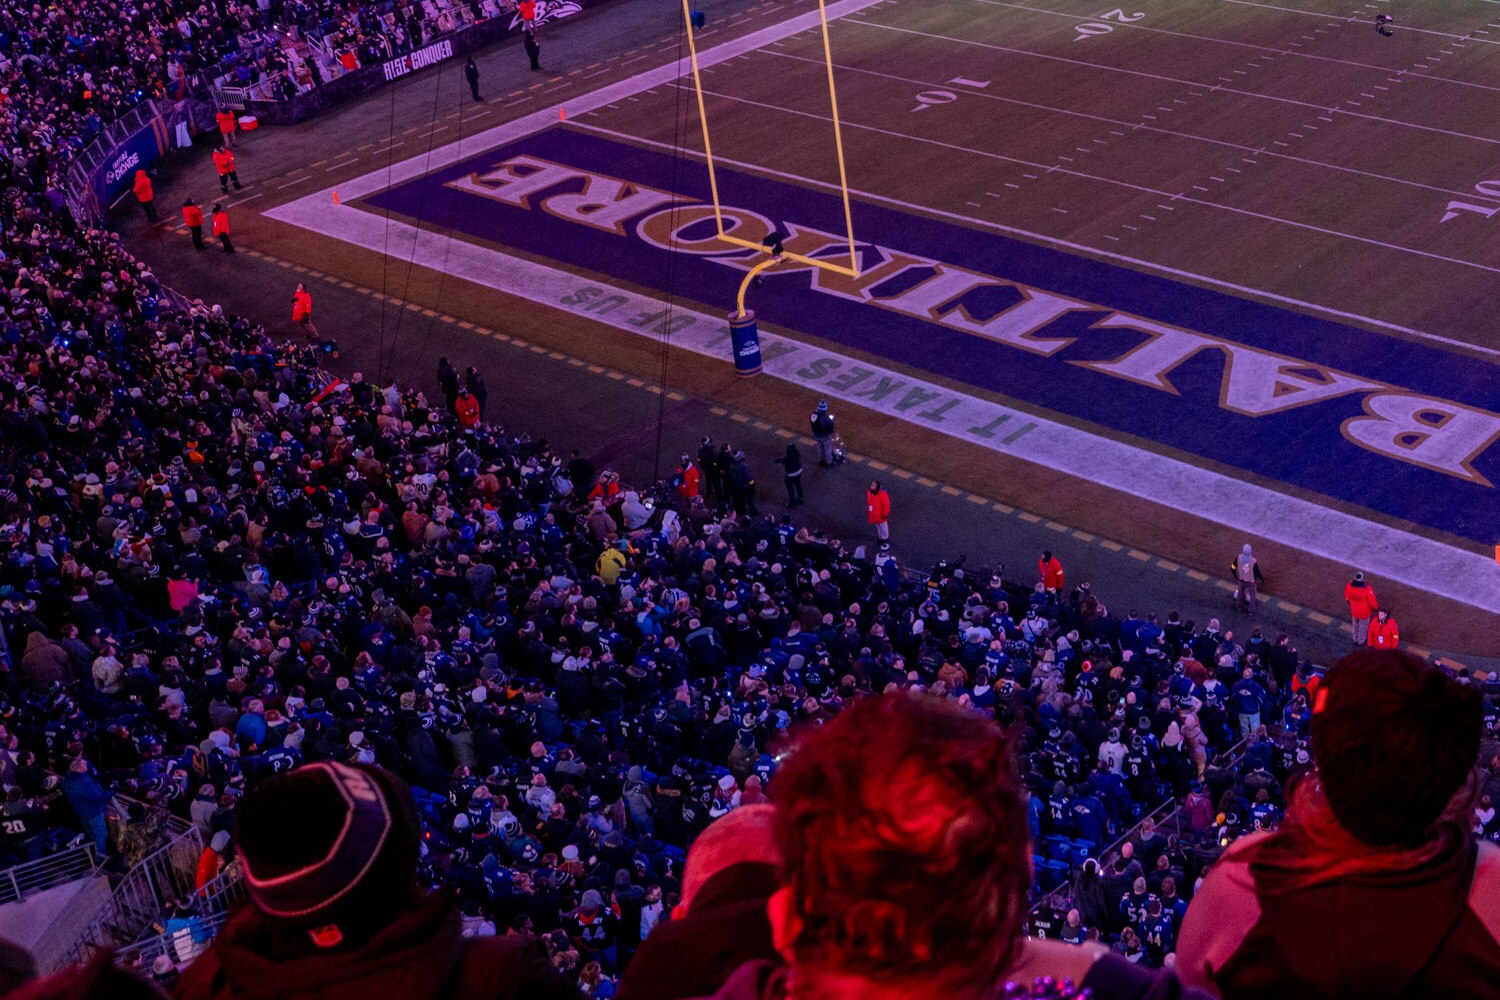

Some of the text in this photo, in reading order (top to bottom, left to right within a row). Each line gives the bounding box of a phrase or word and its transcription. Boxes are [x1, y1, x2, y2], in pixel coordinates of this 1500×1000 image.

[382, 40, 453, 80] RISE CONQUER
[560, 287, 1038, 445] IT TAKES AL OF US
[1131, 764, 1139, 776] 8
[2, 820, 26, 835] 20
